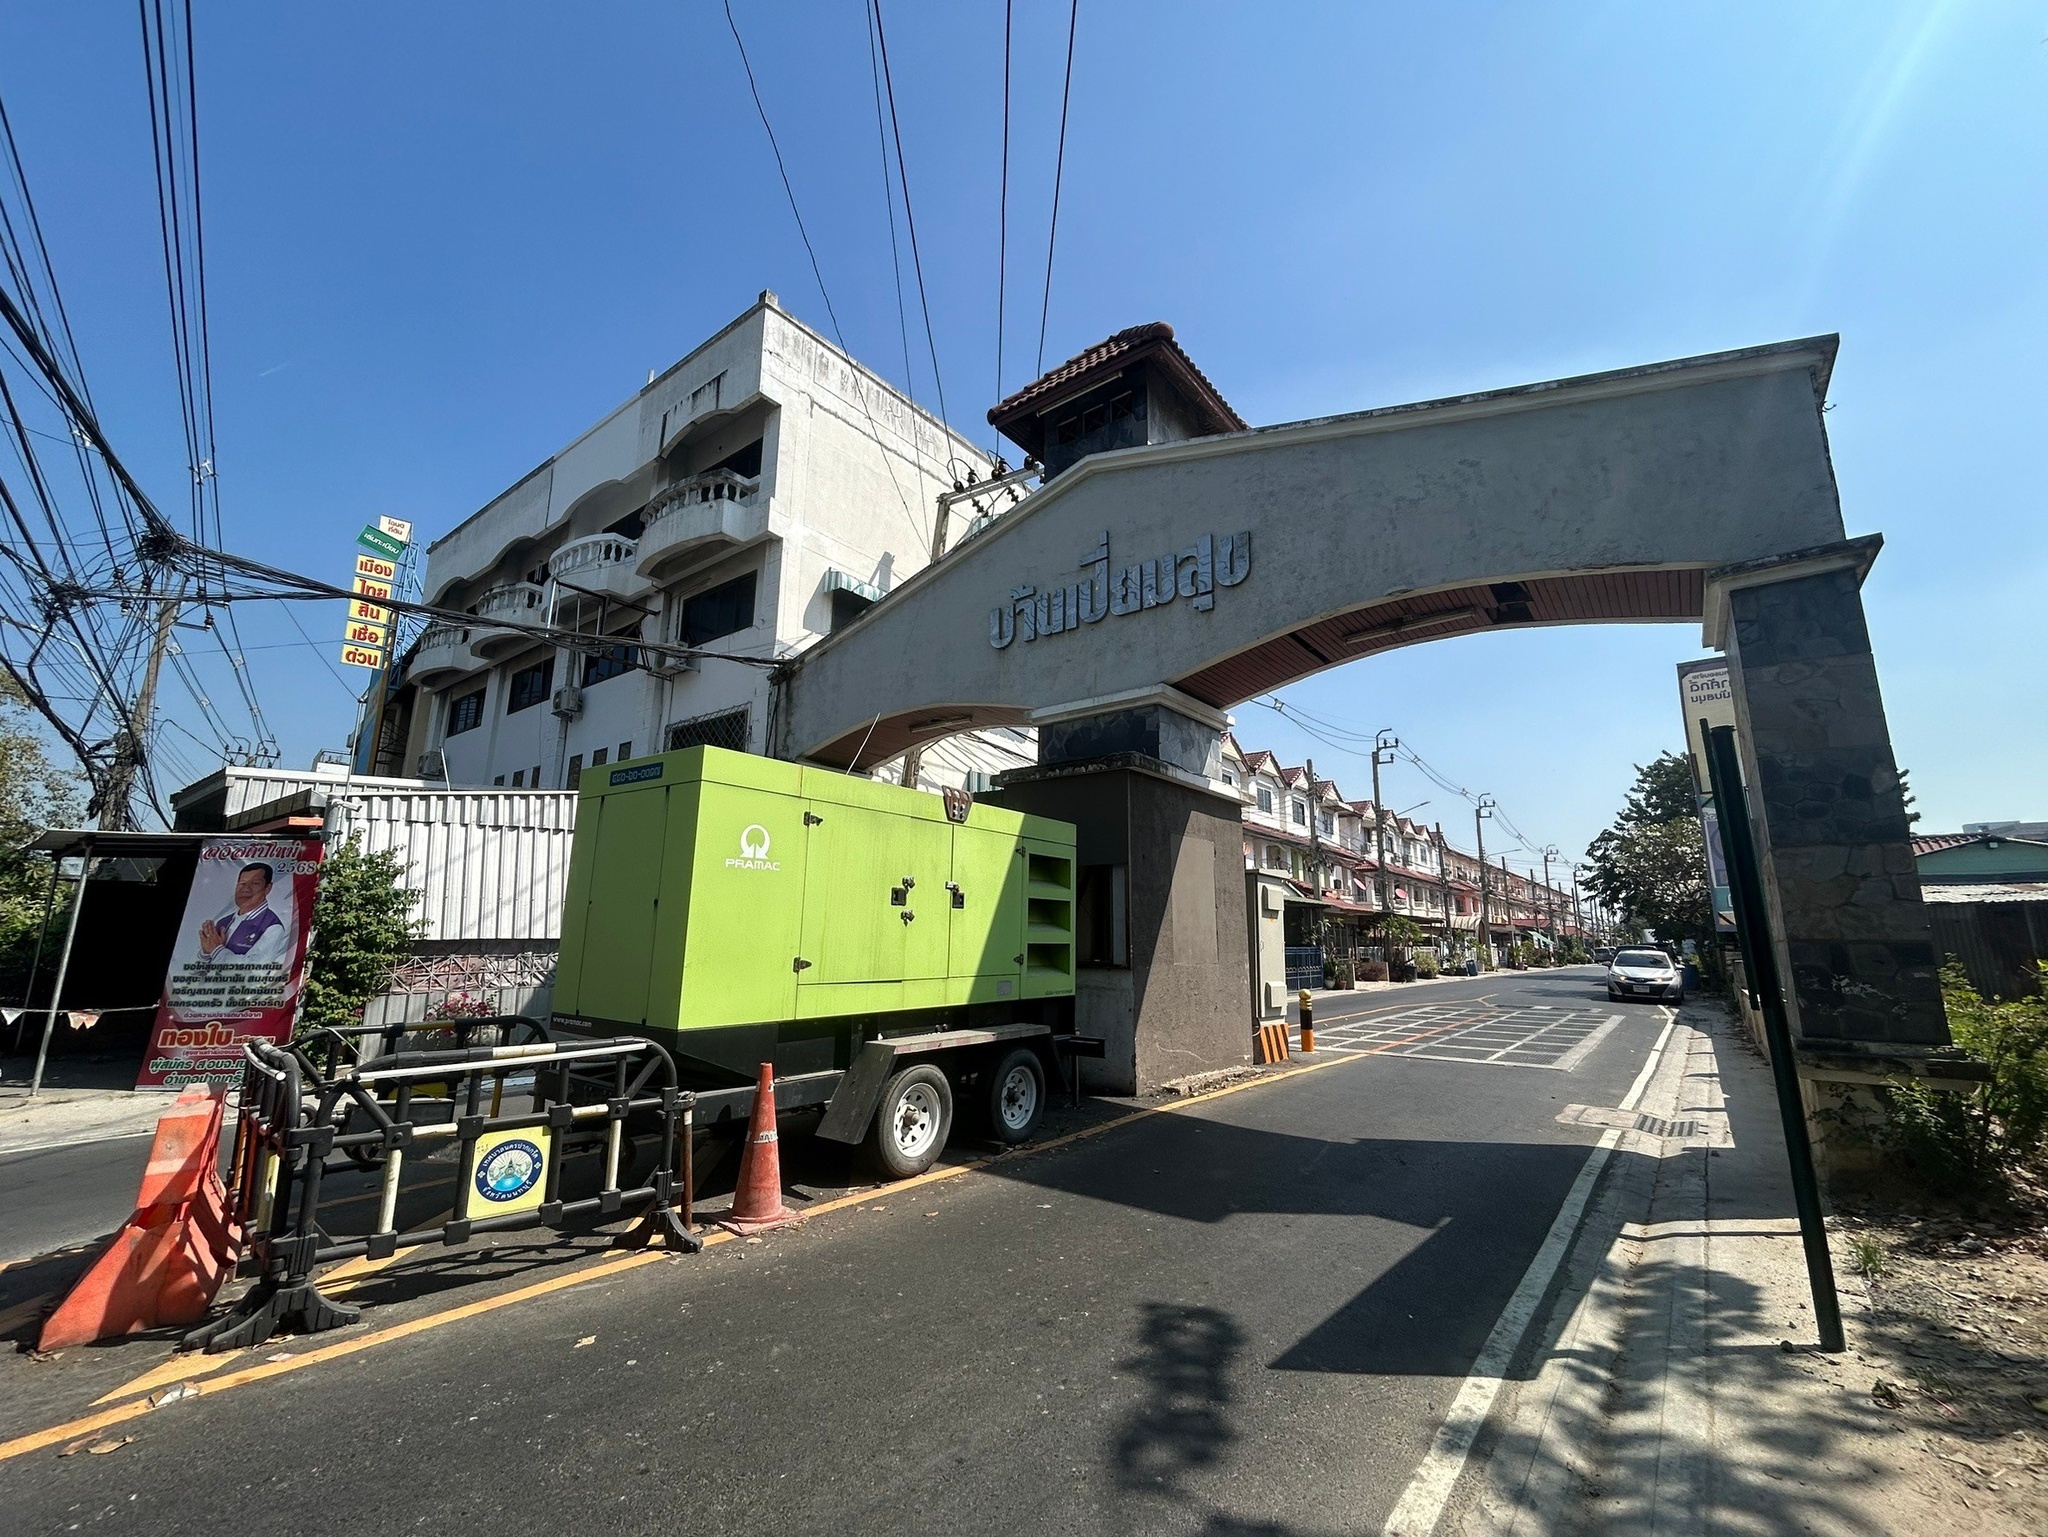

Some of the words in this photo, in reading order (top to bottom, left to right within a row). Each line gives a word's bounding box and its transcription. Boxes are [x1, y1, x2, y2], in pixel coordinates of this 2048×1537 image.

[358, 559, 393, 577] เมือง
[359, 578, 388, 600] ไทย
[989, 530, 1250, 650] บ้านเปี่ยมสุข
[357, 602, 381, 621] สิน
[351, 625, 379, 642] เชื่อ
[345, 648, 379, 667] ด่วน
[203, 841, 301, 860] สวัสดีปีใหม่
[276, 860, 316, 874] 2568
[725, 858, 781, 871] PRAMAC
[160, 1021, 233, 1047] ทองใบ
[150, 1058, 193, 1073] ผู้สมัคร
[164, 1070, 243, 1084] อำเภอปากเกร็
[482, 1142, 539, 1167] เทศบาลนครปากเกร็ด
[482, 1180, 533, 1200] จังหวัดนนทบุรี
